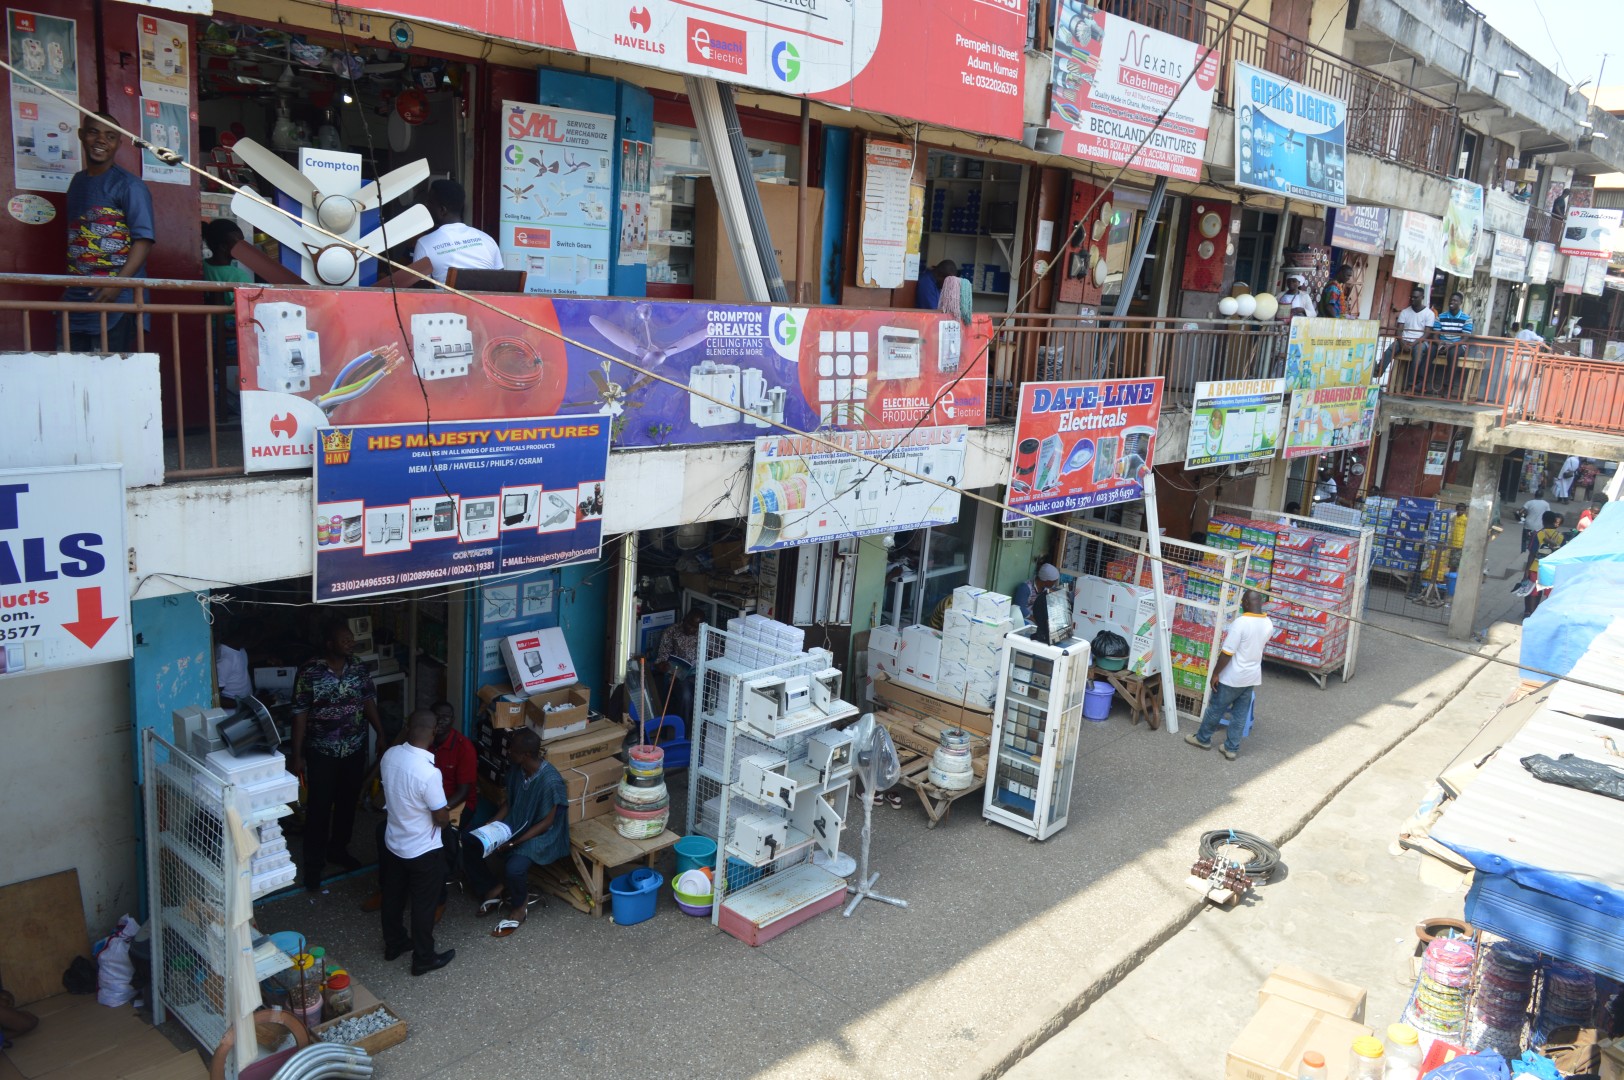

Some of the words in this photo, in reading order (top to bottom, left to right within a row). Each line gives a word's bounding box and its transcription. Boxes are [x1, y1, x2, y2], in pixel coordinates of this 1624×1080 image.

[614, 33, 665, 54] HAVELLS
[956, 33, 991, 54] Prempeh
[709, 49, 743, 65] Electric
[1120, 30, 1182, 79] Nexans
[967, 55, 993, 73] Adum,
[994, 61, 1018, 79] Kumasi
[961, 71, 975, 86] Tel:
[1122, 70, 1177, 97] Kabelmetal
[1251, 75, 1294, 114] GIFRIS
[1296, 91, 1337, 129] LIGHTS
[508, 112, 565, 143] SML
[567, 119, 596, 130] SERVICES
[565, 137, 589, 146] LIMITED
[566, 128, 608, 140] MERCHANDIZE
[1091, 117, 1146, 143] BECKLAND
[1149, 131, 1197, 155] VENTURES
[305, 157, 360, 172] Crompton
[556, 240, 575, 248] Switch
[707, 310, 762, 323] CROMPTON
[707, 323, 762, 337] GREAVES
[707, 338, 738, 348] CEILING
[741, 338, 763, 348] FANS
[707, 348, 737, 356] BLENDERS
[739, 348, 745, 356] &
[745, 348, 763, 356] MORE
[1225, 380, 1260, 395] PACIFIC
[1260, 379, 1276, 393] ENT
[882, 397, 930, 408] ELECTRICAL
[1032, 383, 1155, 414] DATE-LINE
[882, 408, 930, 422] PRODUCTS
[953, 407, 981, 417] Electric
[1058, 408, 1127, 433] Electricals
[368, 435, 402, 450] HIS
[406, 430, 491, 448] MAJESTY
[495, 425, 600, 444] VENTURES
[856, 427, 952, 453] ELECTRICALS
[252, 444, 314, 457] HAVELLS
[489, 445, 526, 453] ELECTRICALS
[526, 442, 556, 451] PRODUCTS
[324, 452, 350, 465] HMV
[408, 465, 428, 474] MEM
[432, 463, 448, 472] ABB
[453, 461, 485, 470] HAVELLS
[490, 458, 514, 468] PHILPS
[518, 456, 543, 467] OSRAM
[1025, 502, 1050, 514] Mobile:
[1051, 501, 1064, 509] 020
[1065, 497, 1076, 509] 815
[1077, 496, 1091, 507] 1370
[1096, 493, 1107, 501] 023
[1107, 490, 1119, 500] 358
[1119, 488, 1134, 499] 6450
[453, 548, 493, 559] CONTACTS
[1135, 637, 1150, 645] EXCEL
